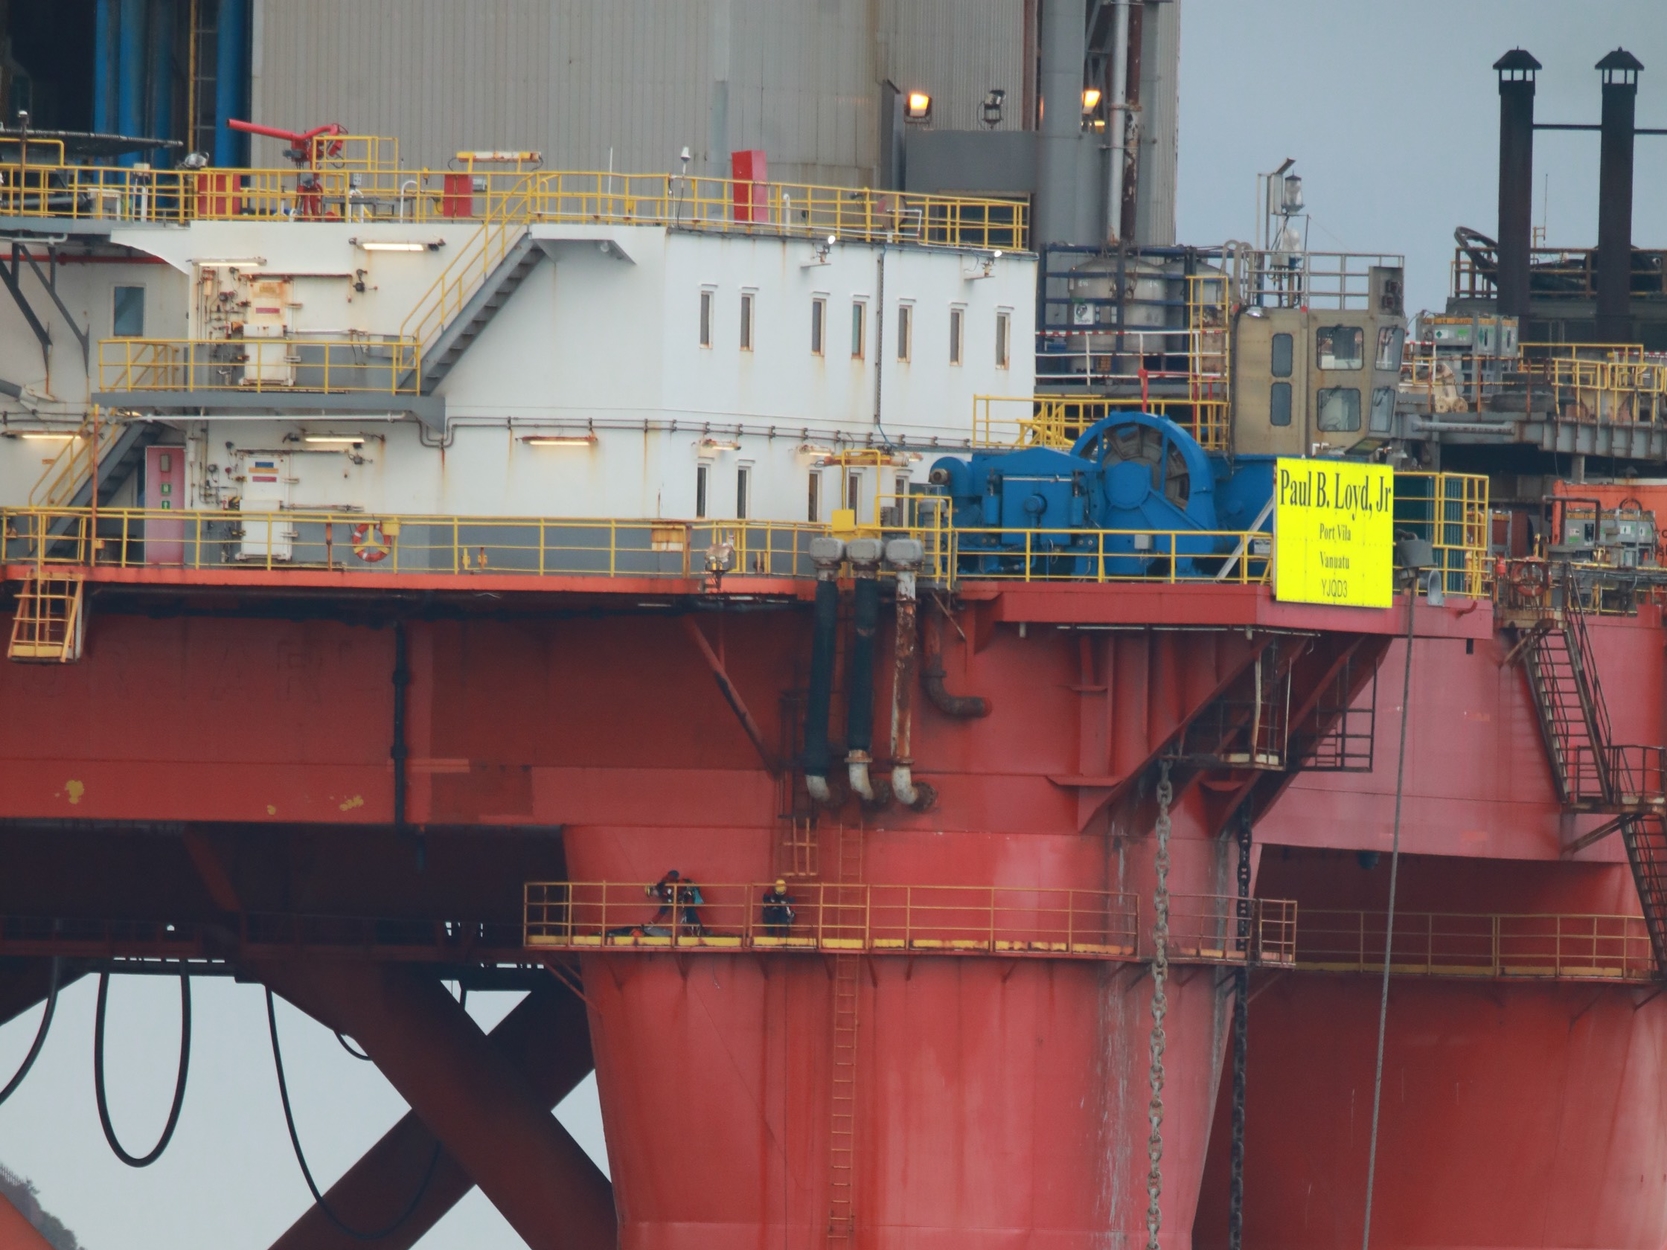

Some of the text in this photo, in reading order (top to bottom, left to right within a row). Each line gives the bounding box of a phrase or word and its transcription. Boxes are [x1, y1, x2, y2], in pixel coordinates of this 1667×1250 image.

[1280, 469, 1391, 521] Paul B. Loyd, Jr
[1319, 523, 1351, 541] Port Vila
[1319, 551, 1350, 570] Vanuatu
[1321, 578, 1348, 598] YJQD3
